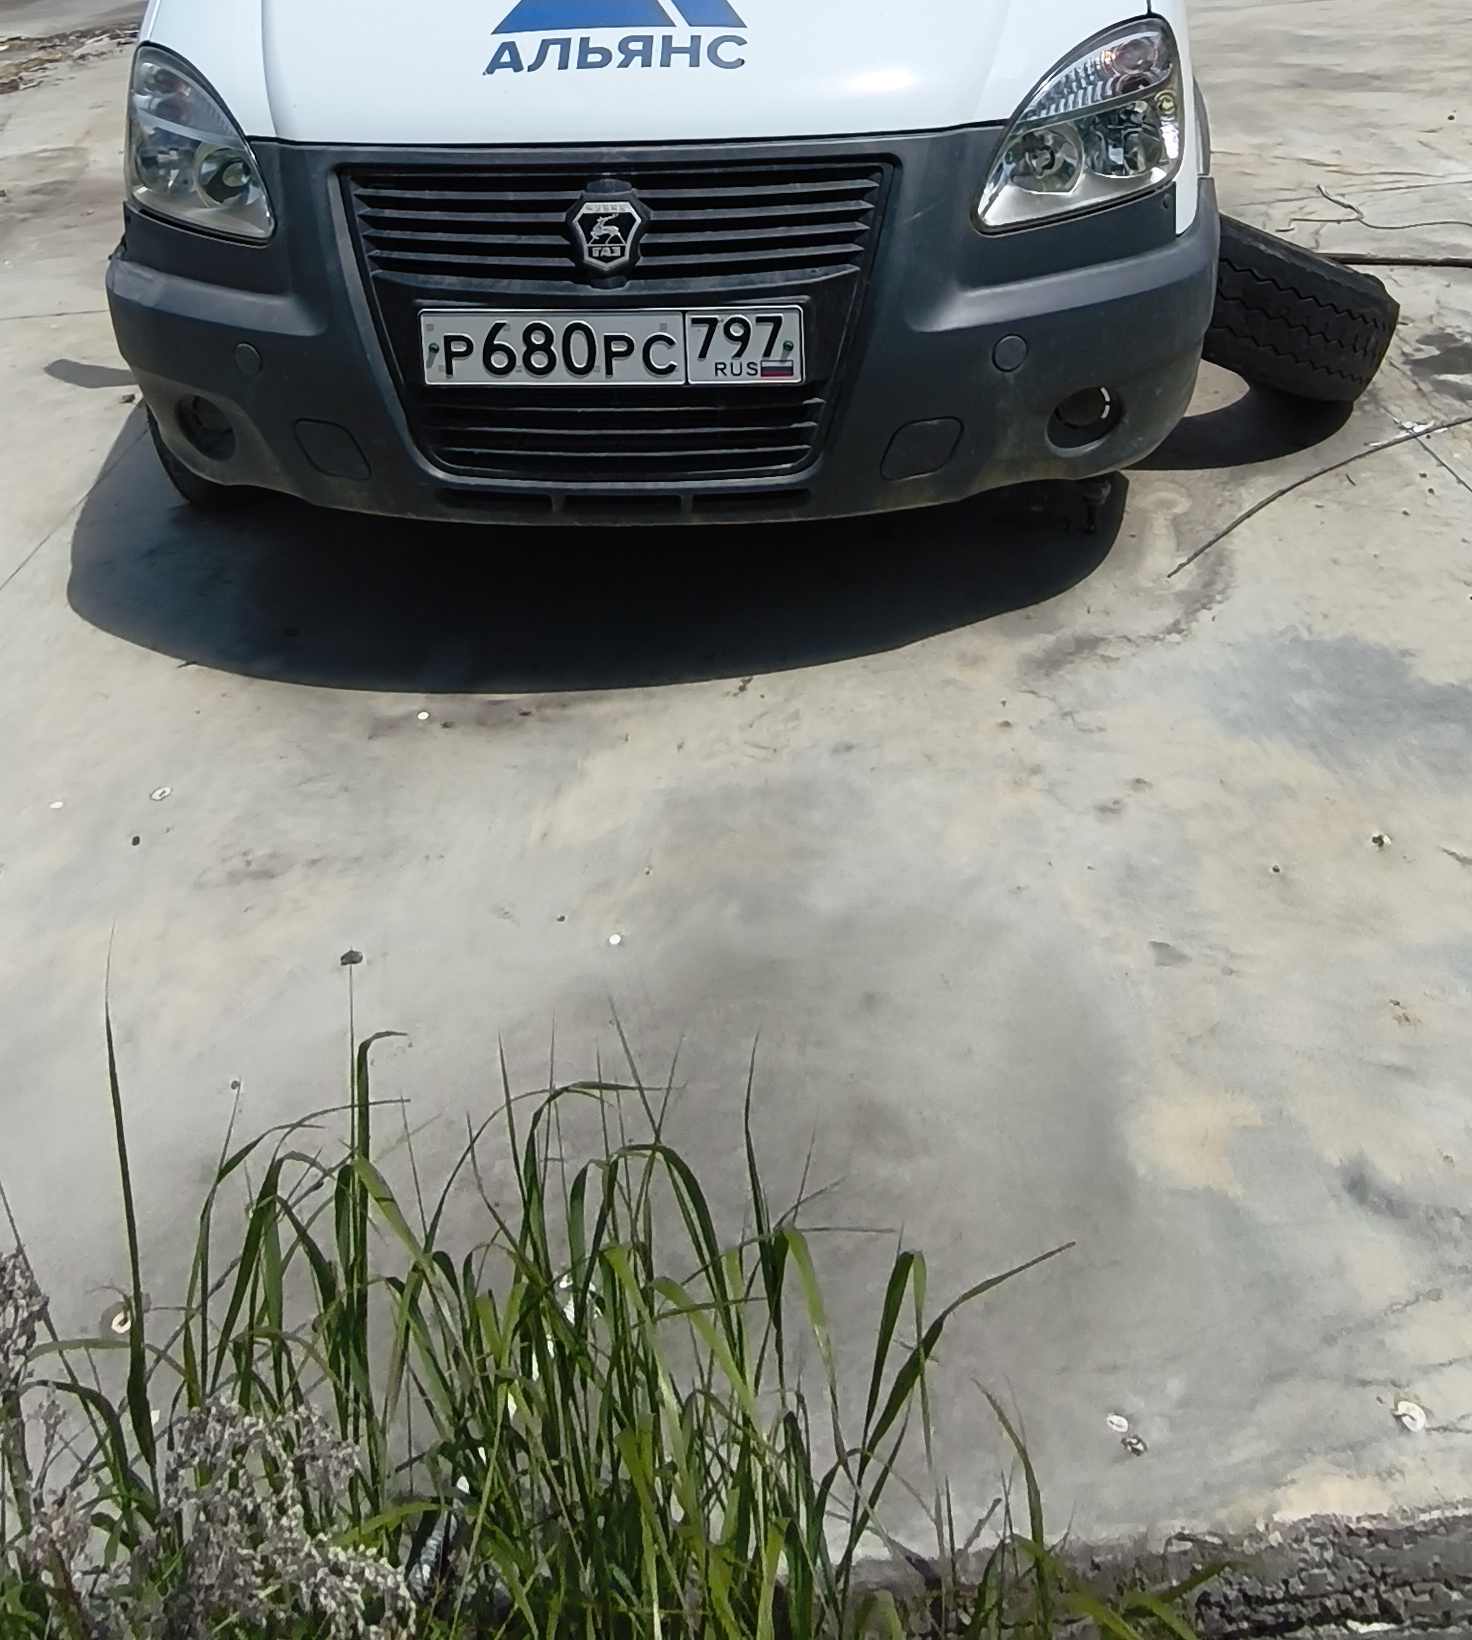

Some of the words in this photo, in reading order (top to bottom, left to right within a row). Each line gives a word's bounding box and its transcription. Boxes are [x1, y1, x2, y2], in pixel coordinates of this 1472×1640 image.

[482, 34, 748, 75] АЛЬЯНС
[690, 316, 784, 360] 797
[714, 362, 758, 376] RUS
